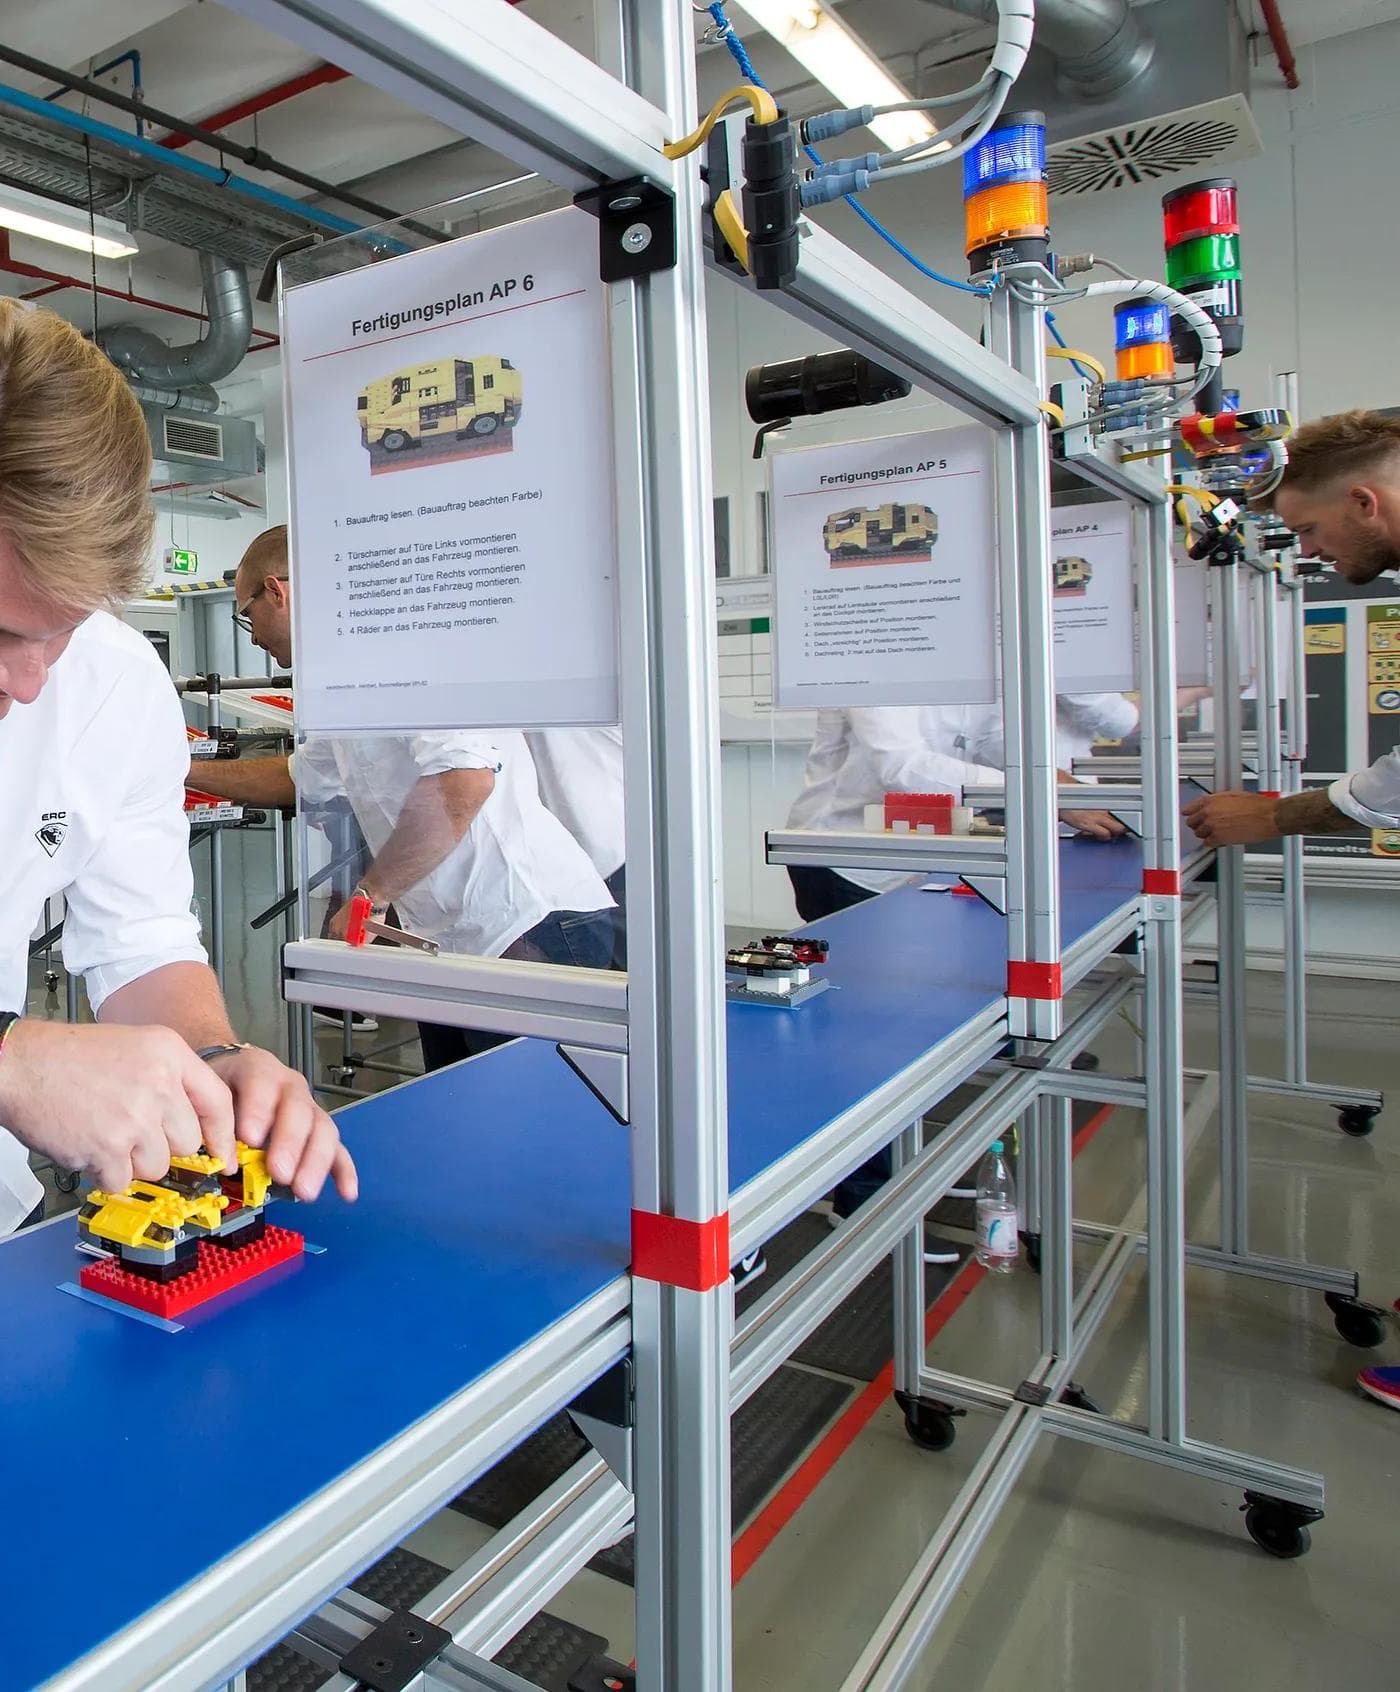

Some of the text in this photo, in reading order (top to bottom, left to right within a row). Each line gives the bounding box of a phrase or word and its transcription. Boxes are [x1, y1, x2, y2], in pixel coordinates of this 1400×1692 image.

[352, 274, 534, 337] Fertigungsplan AP 6
[820, 460, 947, 485] Fertigungsplan AP 5
[334, 519, 341, 527] 1.
[346, 513, 389, 526] Bauauftrag
[417, 502, 466, 517] (Bauauftrag
[469, 496, 509, 508] beachten
[512, 489, 543, 502] Farbe)
[1075, 525, 1090, 533] AP
[335, 532, 516, 562] 2. Türscharnier auf Türe Links vormontieren
[348, 544, 521, 572] anschließend an das Fahrzeug montieren.
[336, 563, 526, 590] 3. Türscharnier auf Türe Rechts vormontieren
[349, 576, 522, 601] anschließend an das Fahrzeug montieren.
[337, 610, 344, 618] 4.
[350, 607, 395, 618] Heckklappe
[410, 603, 424, 612] das
[427, 600, 467, 612] Fahrzeug
[469, 595, 515, 607] montieren.
[337, 628, 344, 636] 5.
[357, 624, 380, 634] Räder
[395, 622, 410, 631] das
[412, 619, 451, 630] Fahrzeug
[454, 615, 499, 627] montieren.
[41, 811, 67, 821] ERC
